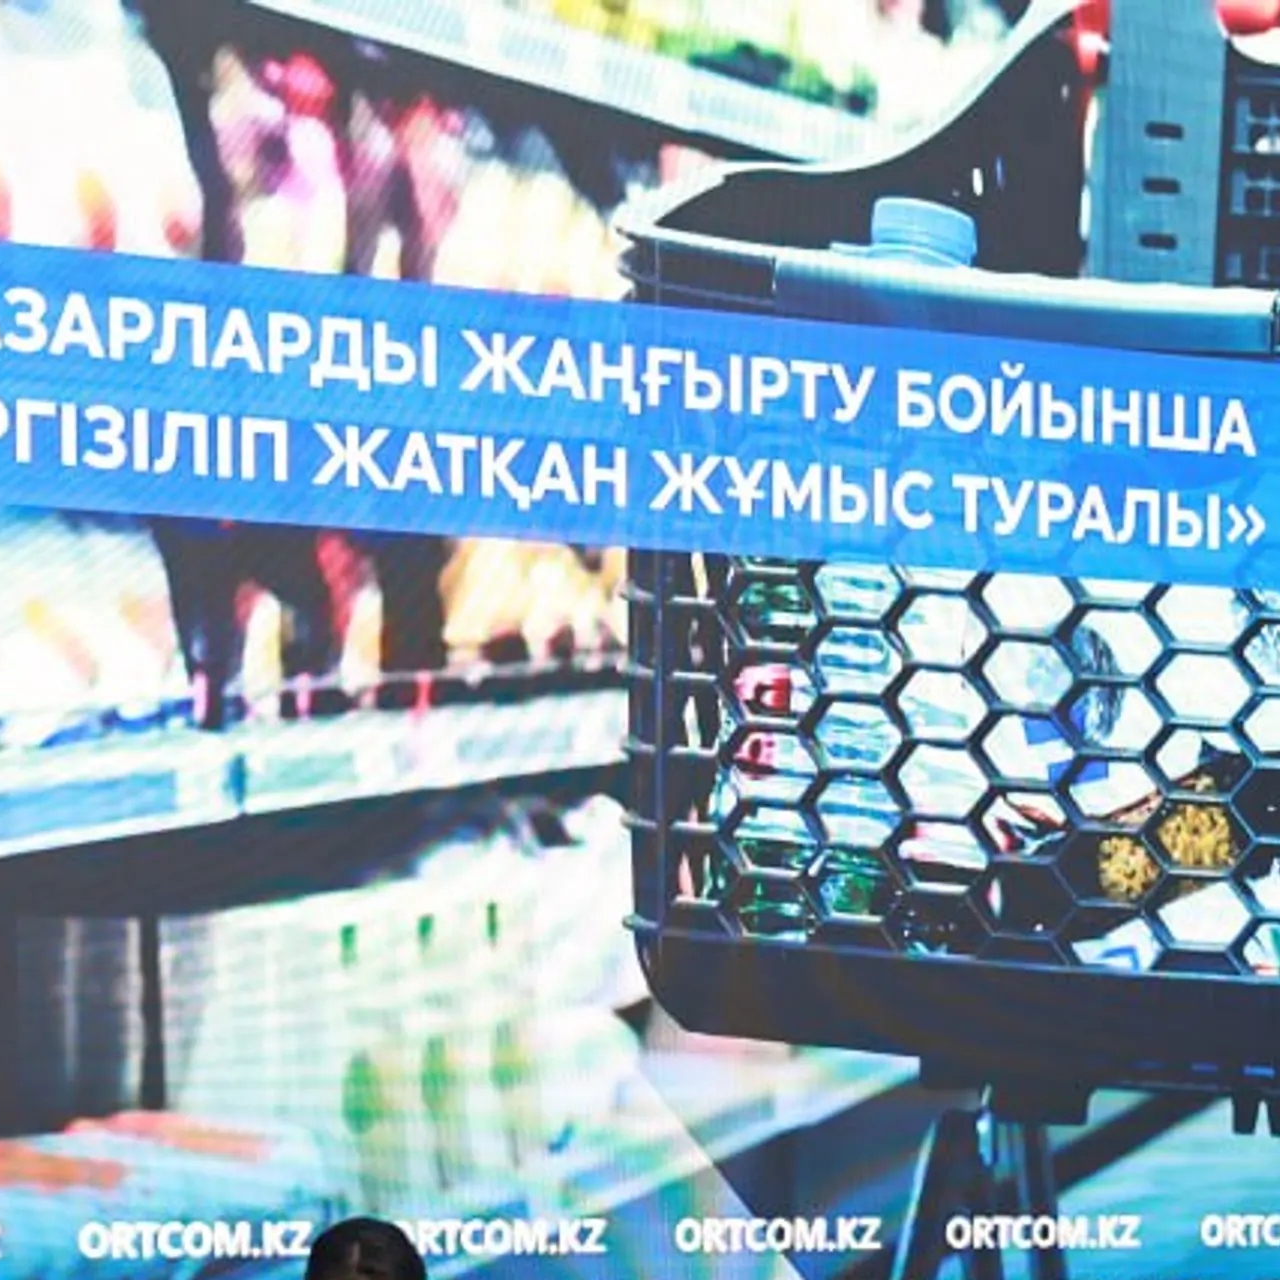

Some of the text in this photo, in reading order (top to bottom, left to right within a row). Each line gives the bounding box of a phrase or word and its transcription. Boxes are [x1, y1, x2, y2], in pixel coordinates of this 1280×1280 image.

[460, 329, 876, 422] ЖАҢҒЫРТУ
[897, 362, 1256, 456] БОЙЫНША
[313, 423, 628, 511] ЖАТҚАН
[650, 451, 934, 530] ЖҰМЫС
[952, 474, 1266, 550] ТУРАЛЫ»
[77, 1219, 313, 1259] ORTCOM.KZ
[674, 1216, 882, 1254] ORTCOM.KZ
[945, 1214, 1142, 1250] ORTCOM.KZ
